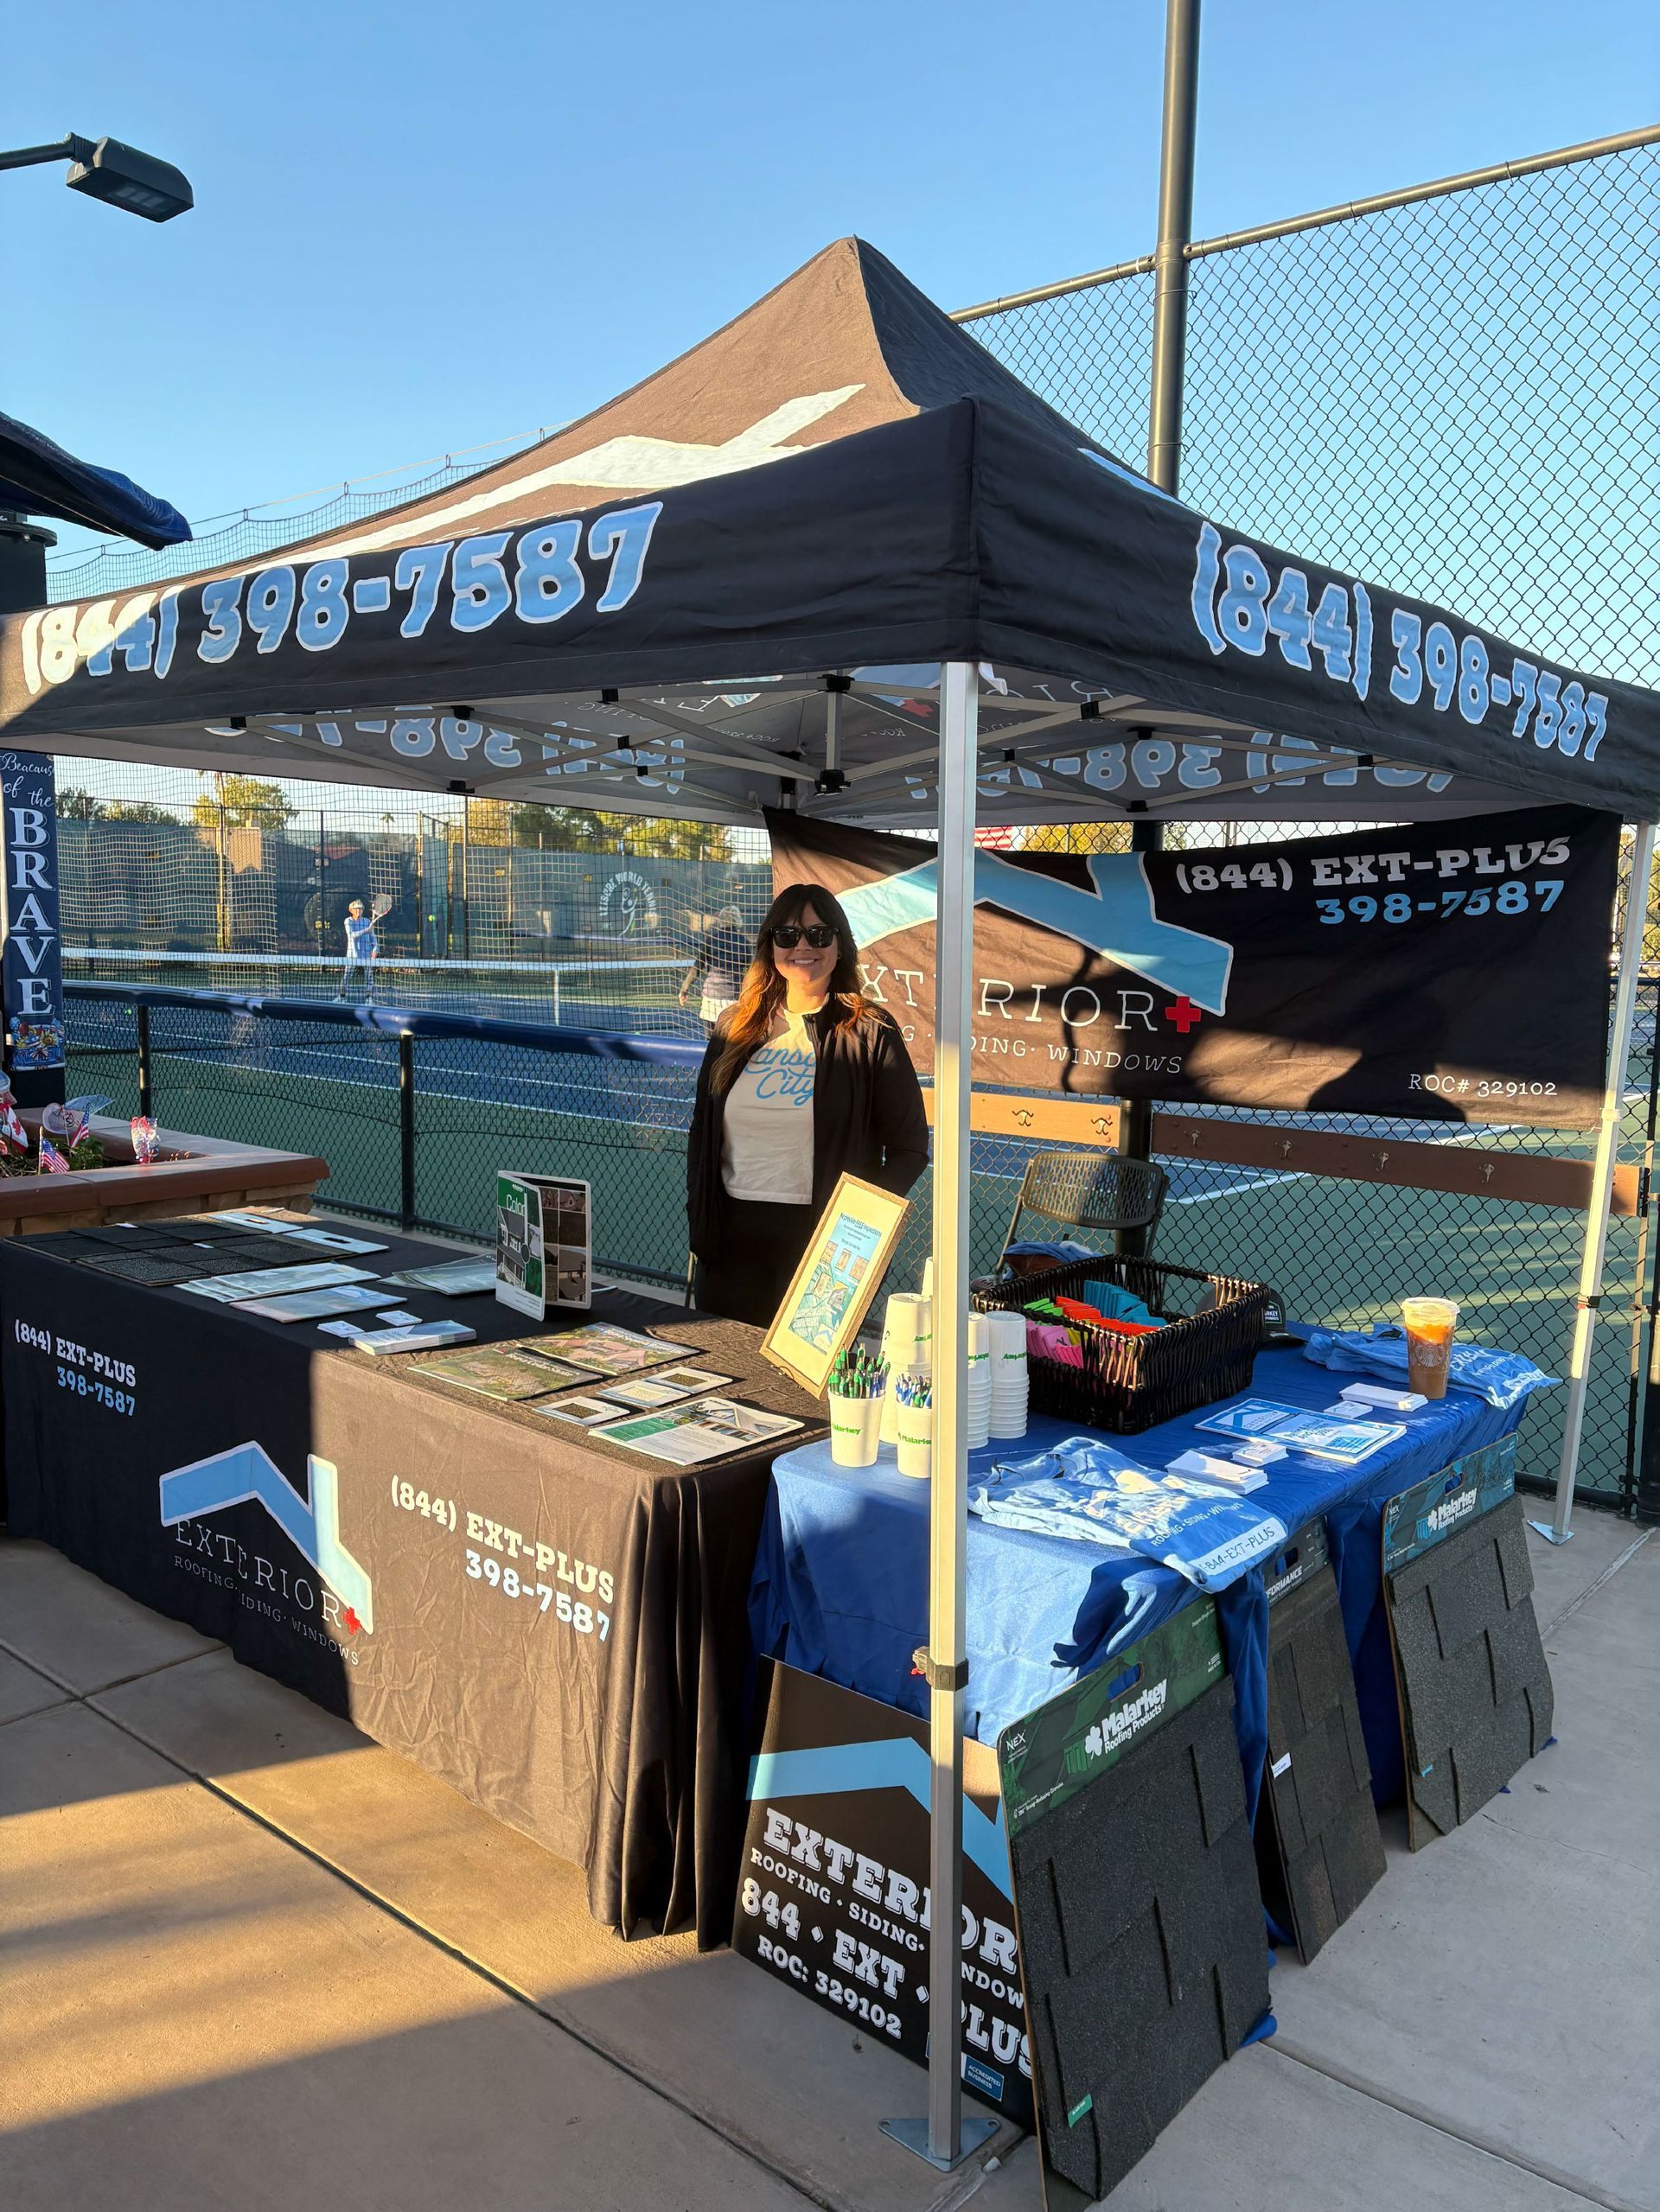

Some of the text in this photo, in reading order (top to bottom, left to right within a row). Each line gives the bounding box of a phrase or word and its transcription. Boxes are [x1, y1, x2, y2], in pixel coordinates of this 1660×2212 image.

[22, 501, 664, 694] (844) 398-7587
[1191, 520, 1609, 762] (844) 398-7587
[3, 775, 54, 807] of the
[615, 870, 643, 887] WORLD
[1176, 836, 1571, 894] (844) EXT-PLUS
[10, 807, 56, 1017] BRAVE
[1316, 880, 1564, 925] 398-7587
[857, 964, 1159, 1032] XTRIOR
[1048, 1044, 1183, 1074] WINDOWS
[756, 1068, 814, 1106] City
[1408, 1074, 1558, 1098] ROC# 329102
[15, 1319, 136, 1387] (844) EXT-PLUS
[56, 1366, 136, 1417] 398-7587
[1438, 1487, 1478, 1522] Malarkey
[1438, 1505, 1473, 1531] Roofing Products
[392, 1475, 614, 1604] (844) EXT-PLUS
[465, 1548, 610, 1642] 398-7587
[1266, 1565, 1303, 1599] FORMANCE
[174, 1555, 359, 1666] ROOFING IDING WINDOWS
[1101, 1679, 1167, 1742] Malarkey
[1104, 1705, 1163, 1755] Roofing Products
[1006, 1731, 1026, 1751] NEX
[750, 1847, 1025, 2010] ROOFING SIDING NDOW
[741, 1877, 1033, 2080] 844 EXT LUS
[758, 1935, 902, 2040] ROC: 329102
[967, 2071, 993, 2090] BUSINESS
[968, 2064, 1001, 2088] ACCREDITED
